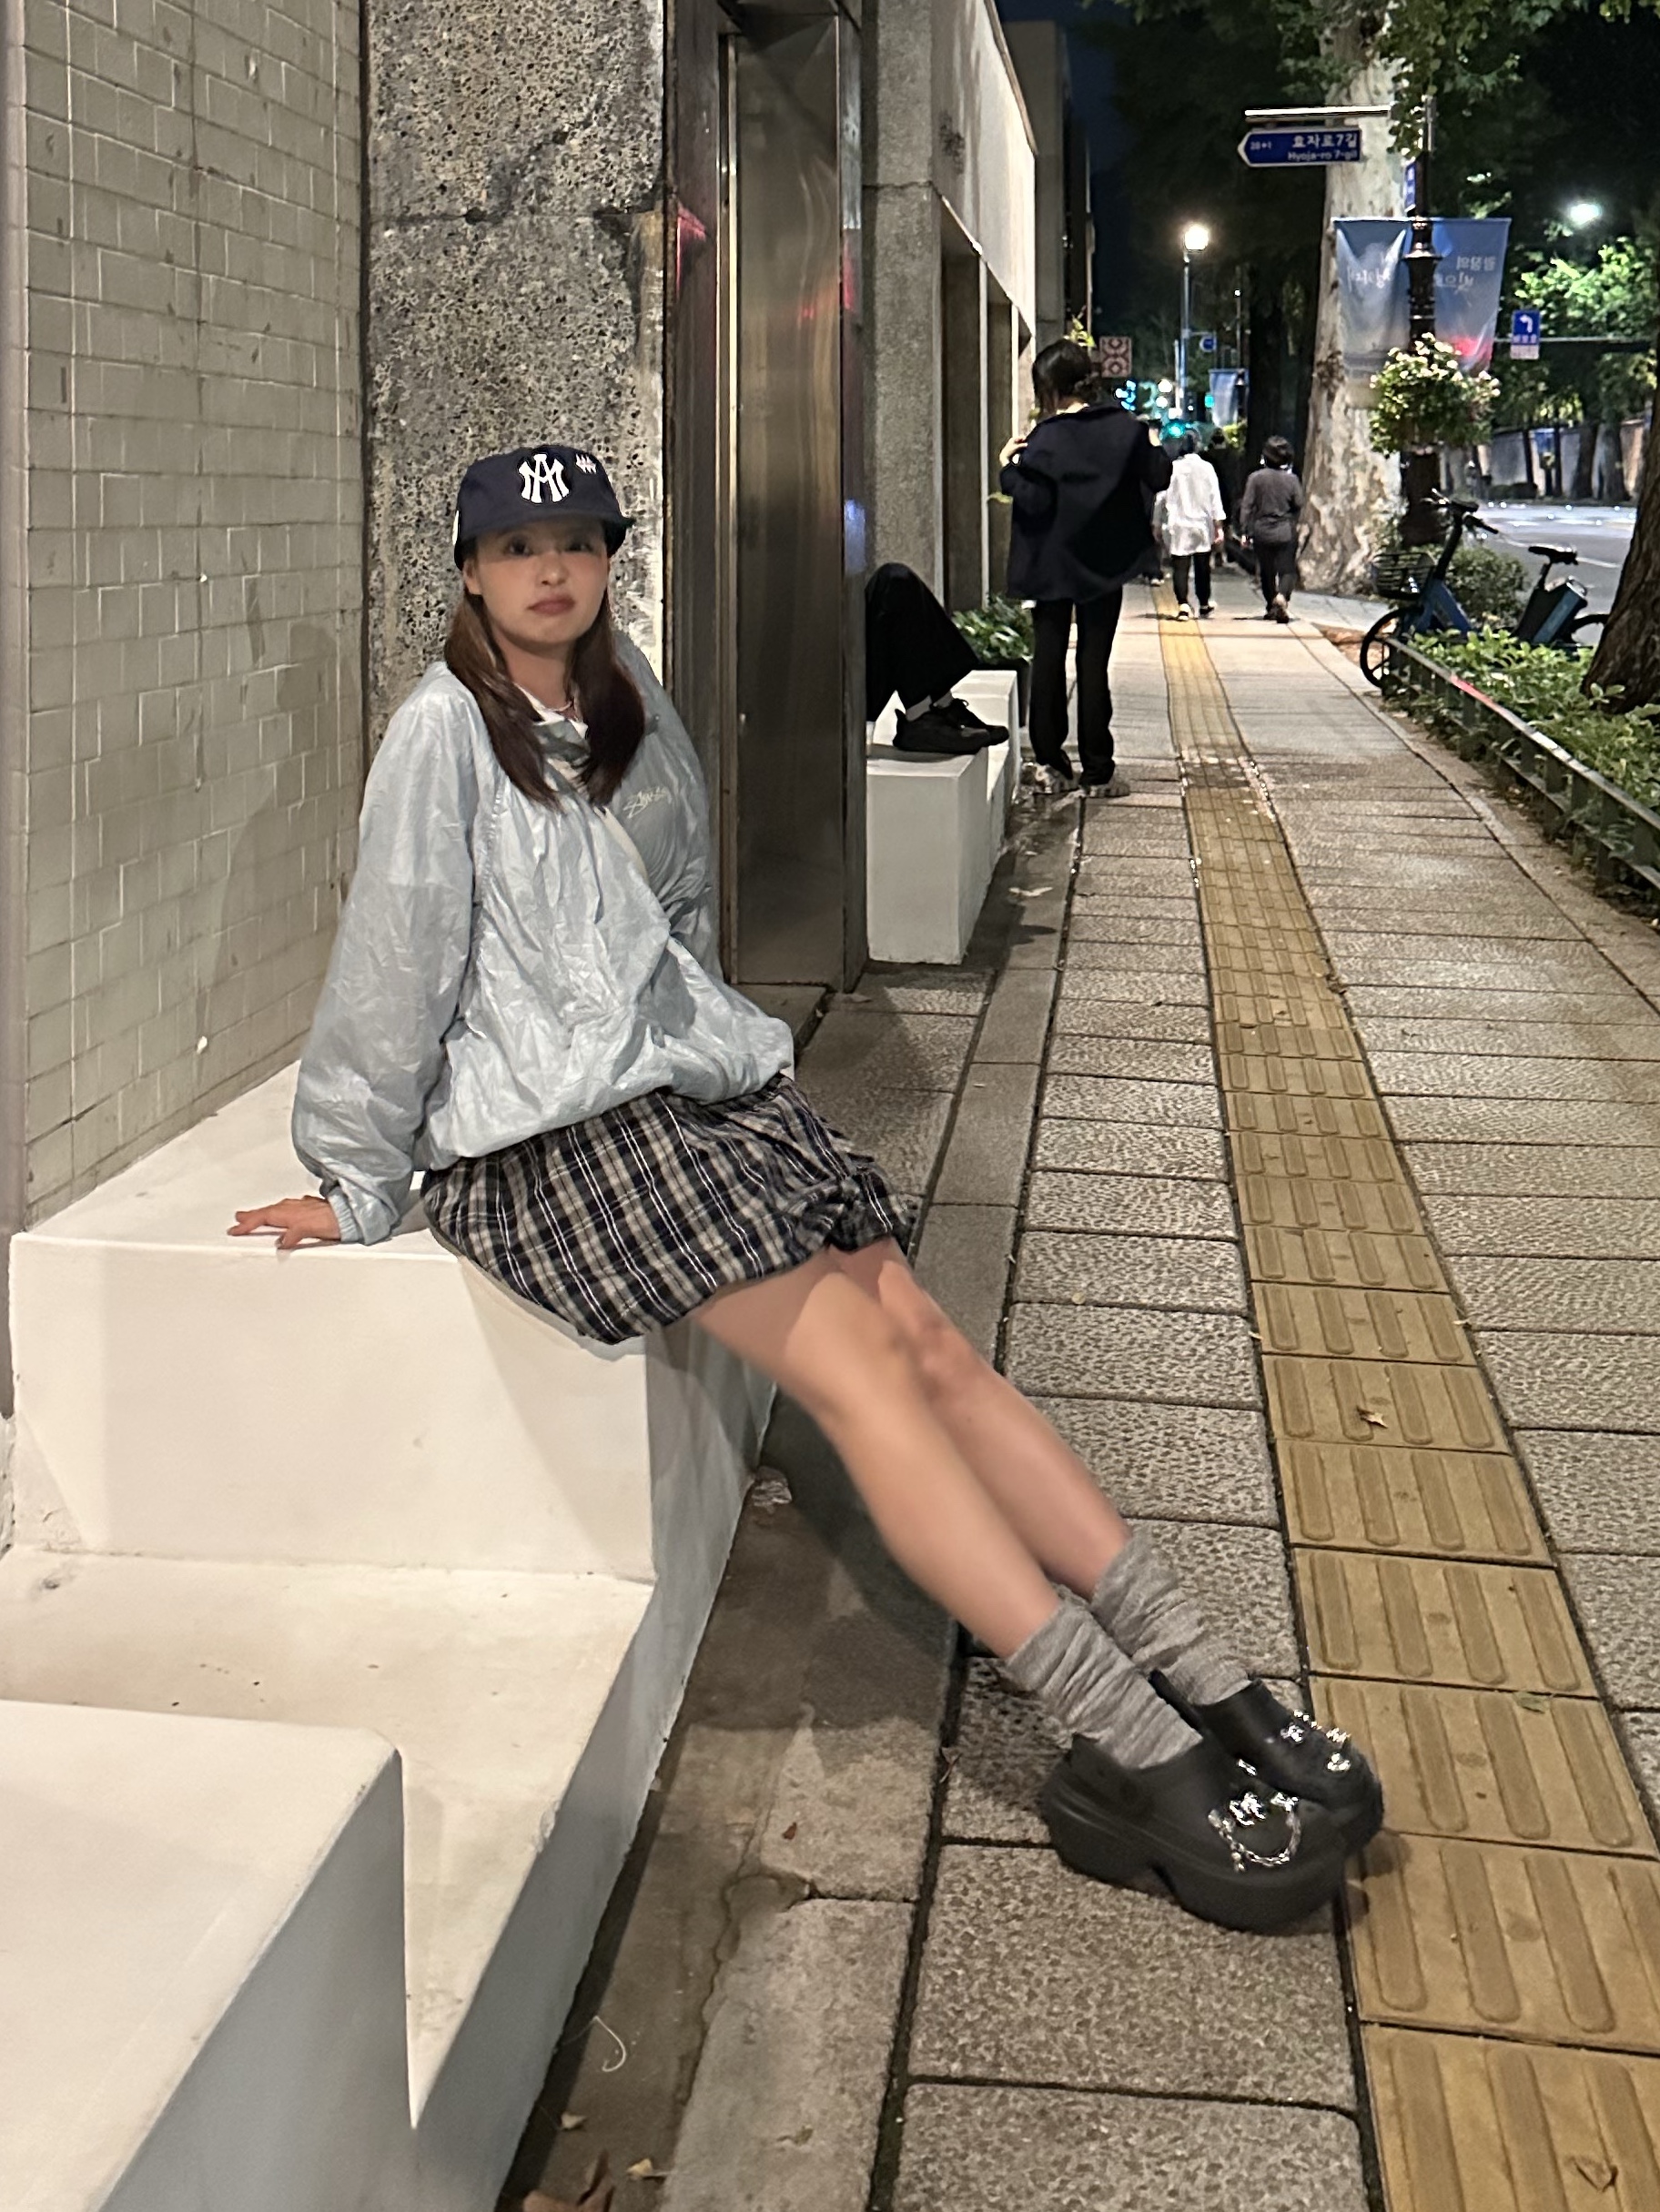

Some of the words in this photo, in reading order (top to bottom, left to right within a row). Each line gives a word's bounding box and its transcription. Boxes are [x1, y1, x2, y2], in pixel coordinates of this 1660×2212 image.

[1292, 133, 1358, 149] 효자로7길
[1288, 151, 1332, 162] Hyoja-ro
[1334, 149, 1358, 160] 7-gil
